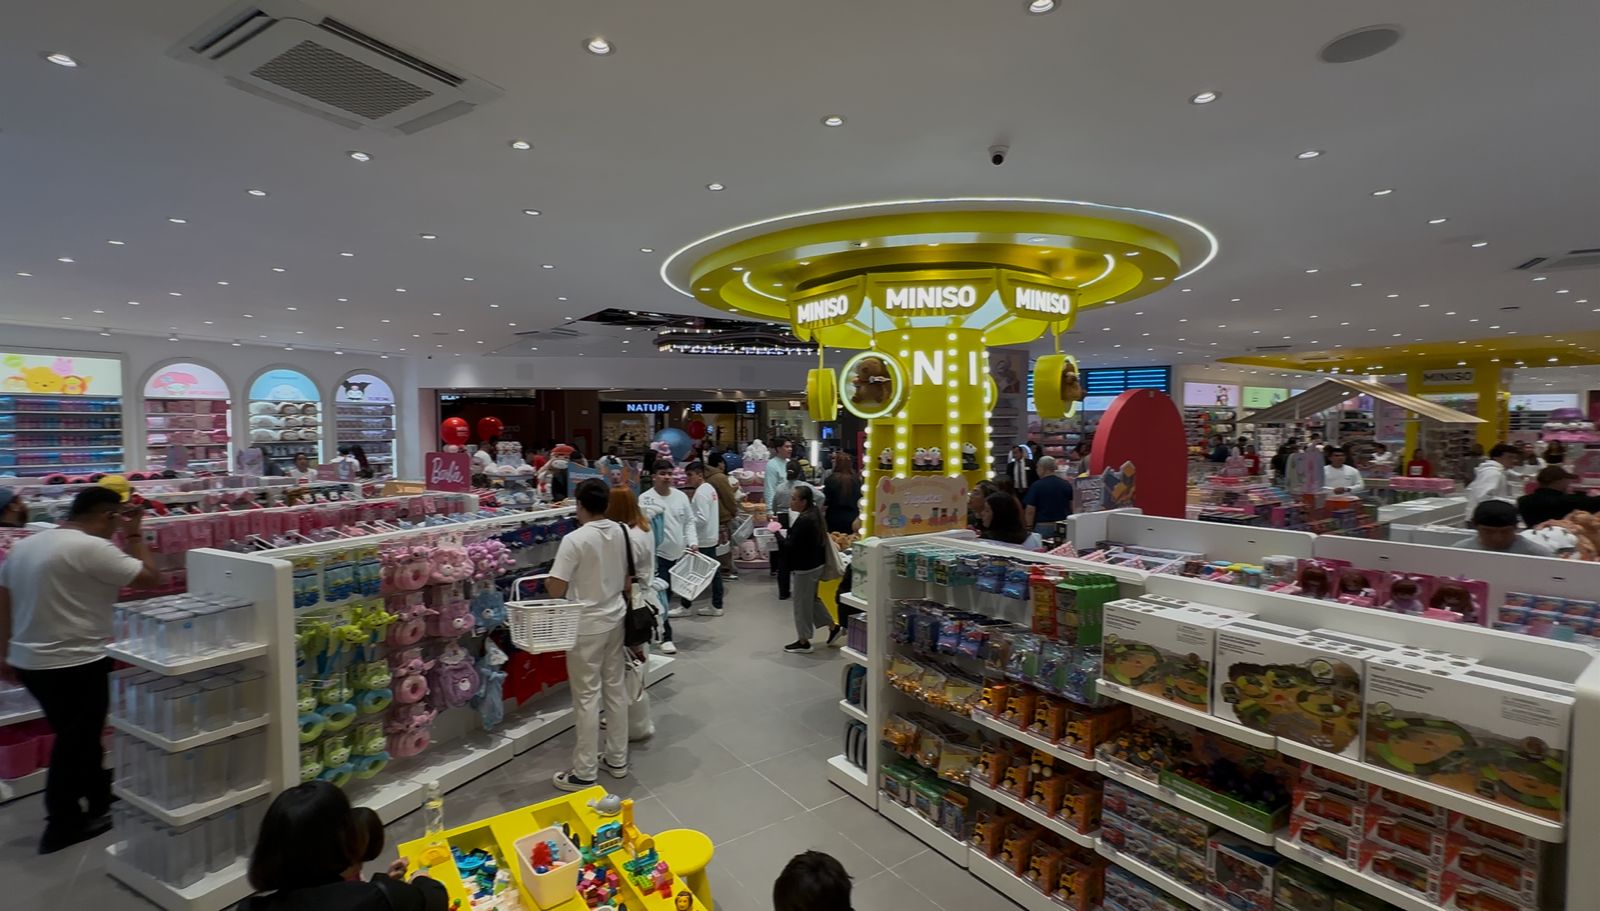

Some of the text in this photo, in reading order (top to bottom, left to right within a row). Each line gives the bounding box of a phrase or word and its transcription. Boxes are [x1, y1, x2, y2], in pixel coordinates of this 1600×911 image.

[797, 294, 849, 324] MINISO
[886, 286, 976, 309] MINISO
[1016, 287, 1070, 314] MINISO
[431, 457, 464, 484] Barbie
